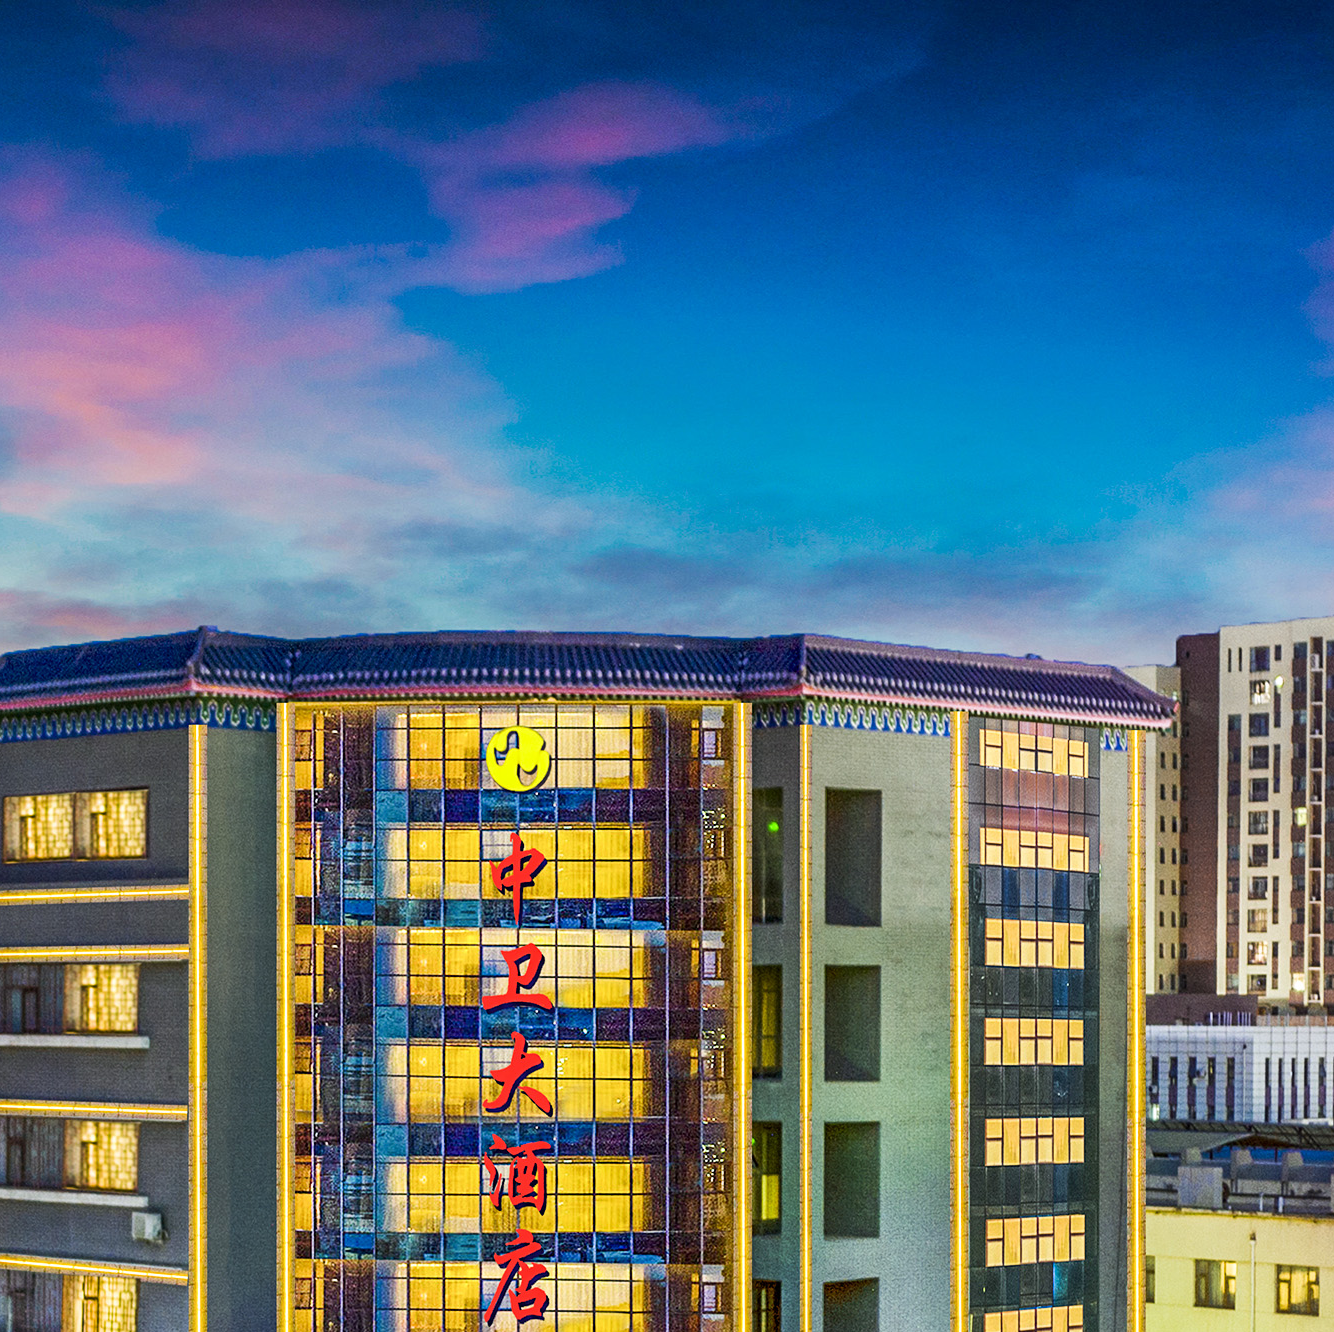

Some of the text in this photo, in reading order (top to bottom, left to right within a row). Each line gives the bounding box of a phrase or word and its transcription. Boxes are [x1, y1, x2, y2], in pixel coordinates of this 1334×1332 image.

[481, 833, 553, 1327] 中卫大酒店
